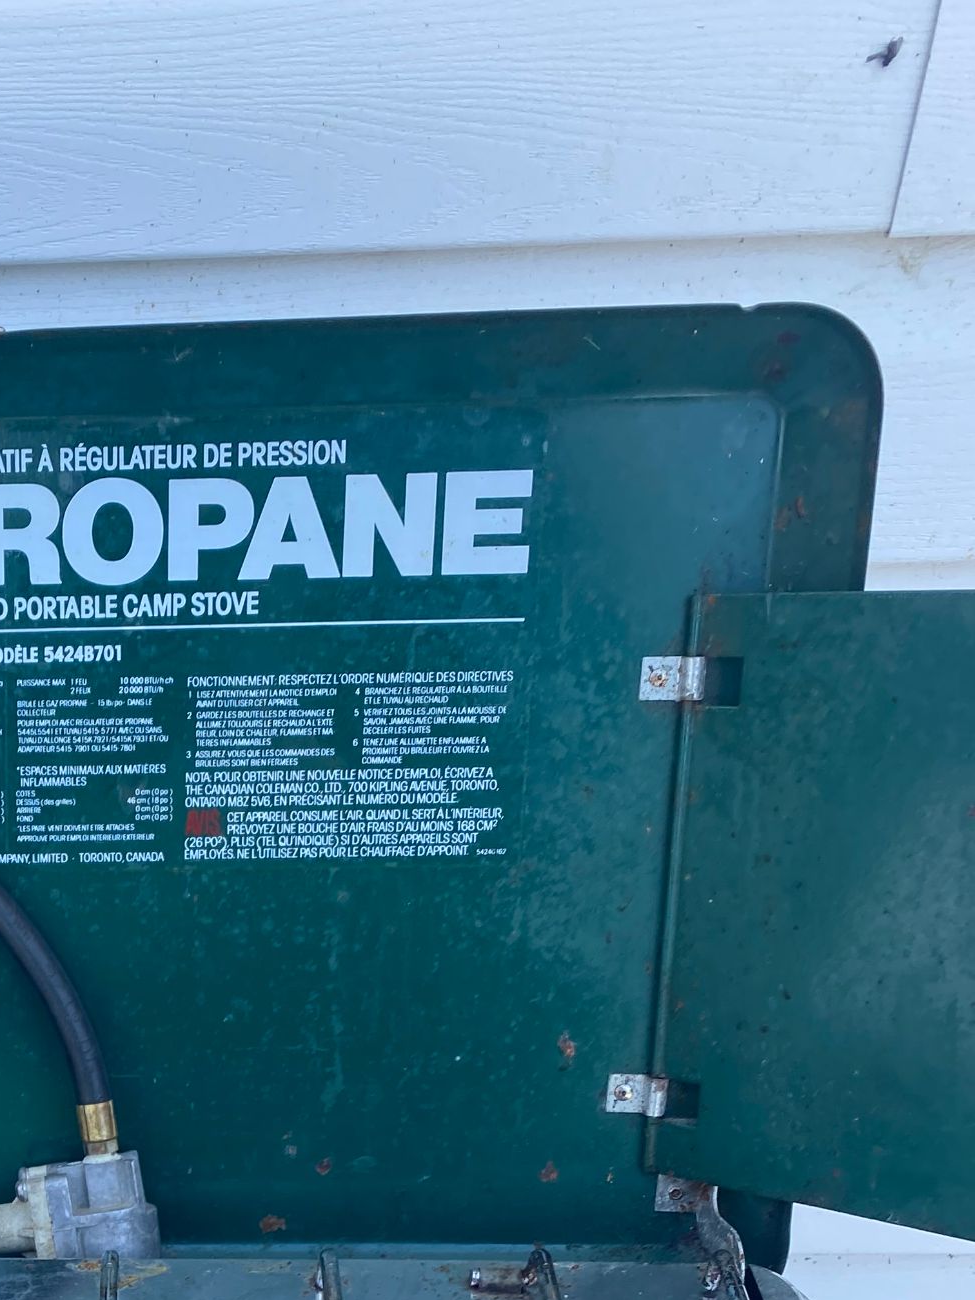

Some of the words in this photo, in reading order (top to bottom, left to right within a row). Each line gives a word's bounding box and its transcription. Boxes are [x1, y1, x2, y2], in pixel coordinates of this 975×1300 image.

[38, 443, 53, 472] À
[59, 443, 197, 470] RÉGULATEUR
[203, 443, 232, 467] DE
[238, 439, 346, 467] PRESSION
[15, 595, 119, 620] PORTABLE
[124, 593, 186, 618] CAMP
[192, 591, 259, 616] STOVE
[44, 644, 122, 662] 5424B701
[187, 675, 276, 687] FONCTIONNEMENT:
[278, 674, 332, 685] RESPECTEZ
[333, 673, 375, 684] L'ORDRE
[376, 670, 434, 684] NUMÉRIQUE
[436, 672, 455, 683] DES
[457, 670, 514, 682] DIRECTIVES
[59, 765, 104, 775] MINIMAUX
[105, 764, 123, 775] AUX
[215, 771, 241, 782] POUR
[242, 771, 284, 781] OBTENIR
[286, 770, 305, 781] UNE
[307, 770, 356, 780] NOUVELLE
[358, 769, 393, 780] NOTICE
[445, 765, 485, 779] ÉCRIVEZ
[20, 776, 87, 787] INFLAMMABLES
[185, 784, 203, 795] THE
[205, 783, 255, 795] CANADIAN
[256, 783, 303, 794] COLEMAN
[348, 781, 368, 792] 700
[370, 781, 408, 792] KIPLING
[409, 780, 449, 792] AVENUE,
[451, 779, 499, 791] TORONTO,
[185, 796, 226, 807] ONTARIO
[228, 796, 249, 807] M8Z
[275, 795, 286, 806] EN
[344, 794, 354, 805] LE
[400, 793, 415, 804] DU
[227, 811, 245, 822] CET
[246, 810, 289, 822] APPAREIL
[290, 810, 338, 821] CONSUME
[366, 809, 400, 820] QUAND
[402, 809, 410, 820] IL
[411, 808, 436, 819] SERT
[227, 822, 275, 835] PRÉVOYEZ
[276, 823, 296, 834] UNE
[298, 823, 338, 834] BOUCHE
[340, 822, 365, 833] D'AIR
[367, 821, 394, 832] FRAIS
[396, 821, 419, 832] D'AU
[420, 821, 453, 832] MOINS
[457, 820, 475, 831] 168
[231, 836, 255, 847] PLUS
[256, 836, 277, 849] (TEL
[352, 834, 398, 845] D'AUTRES
[398, 833, 450, 844] APPAREILS
[451, 832, 478, 843] SONT
[32, 853, 68, 863] LIMITED
[79, 852, 125, 863] TORONTO,
[126, 852, 165, 862] CANADA
[237, 848, 249, 859] NE
[300, 847, 317, 858] PAS
[319, 847, 346, 858] POUR
[348, 846, 359, 857] LE
[360, 845, 416, 857] CHAUFFAGE
